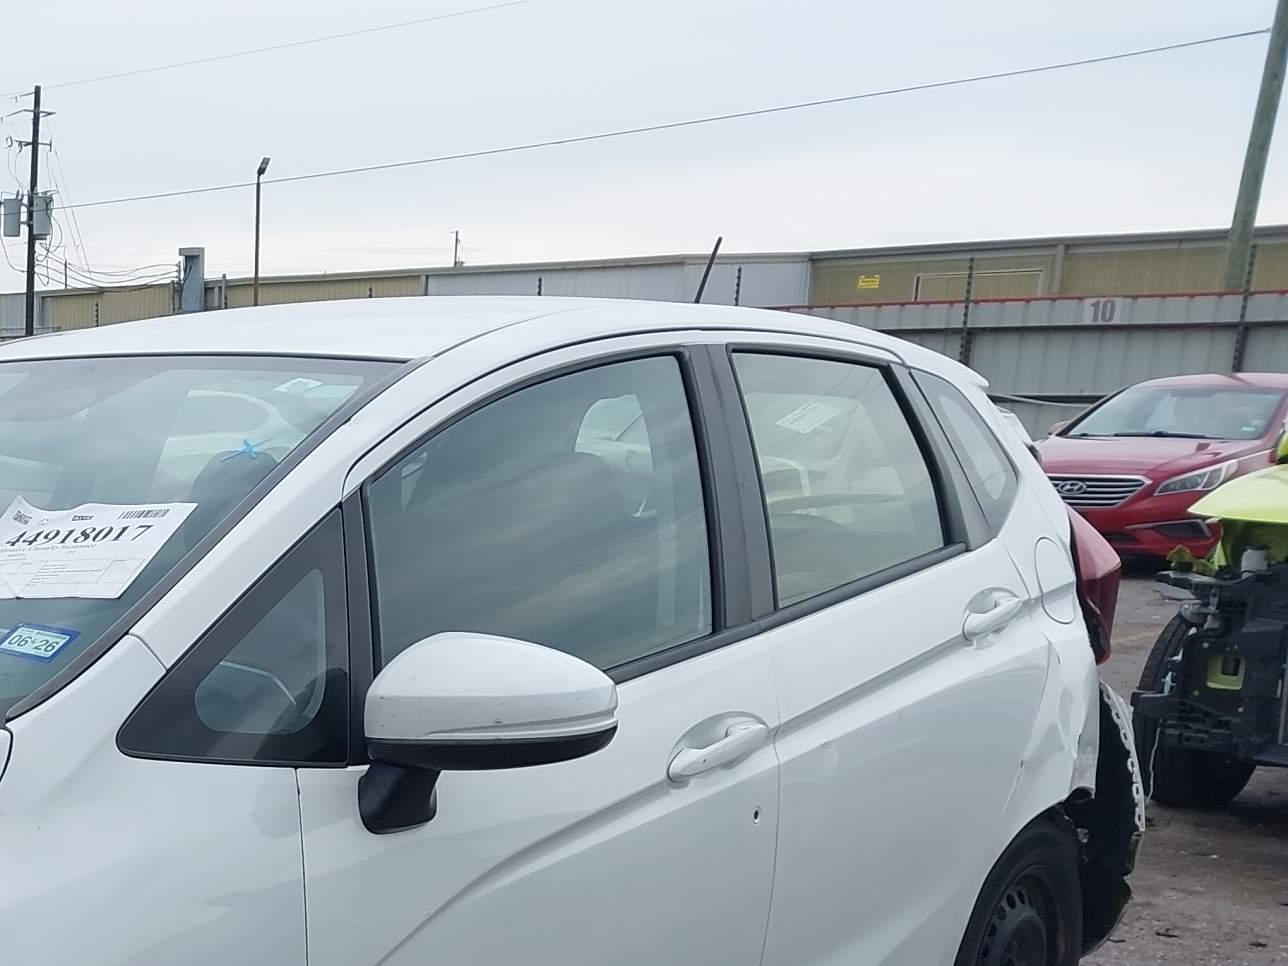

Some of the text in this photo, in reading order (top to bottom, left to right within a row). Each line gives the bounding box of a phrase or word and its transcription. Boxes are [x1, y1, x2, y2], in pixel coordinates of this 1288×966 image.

[1091, 299, 1116, 323] 10
[5, 525, 154, 547] 44918017
[7, 634, 32, 647] 06
[32, 639, 59, 652] 26
